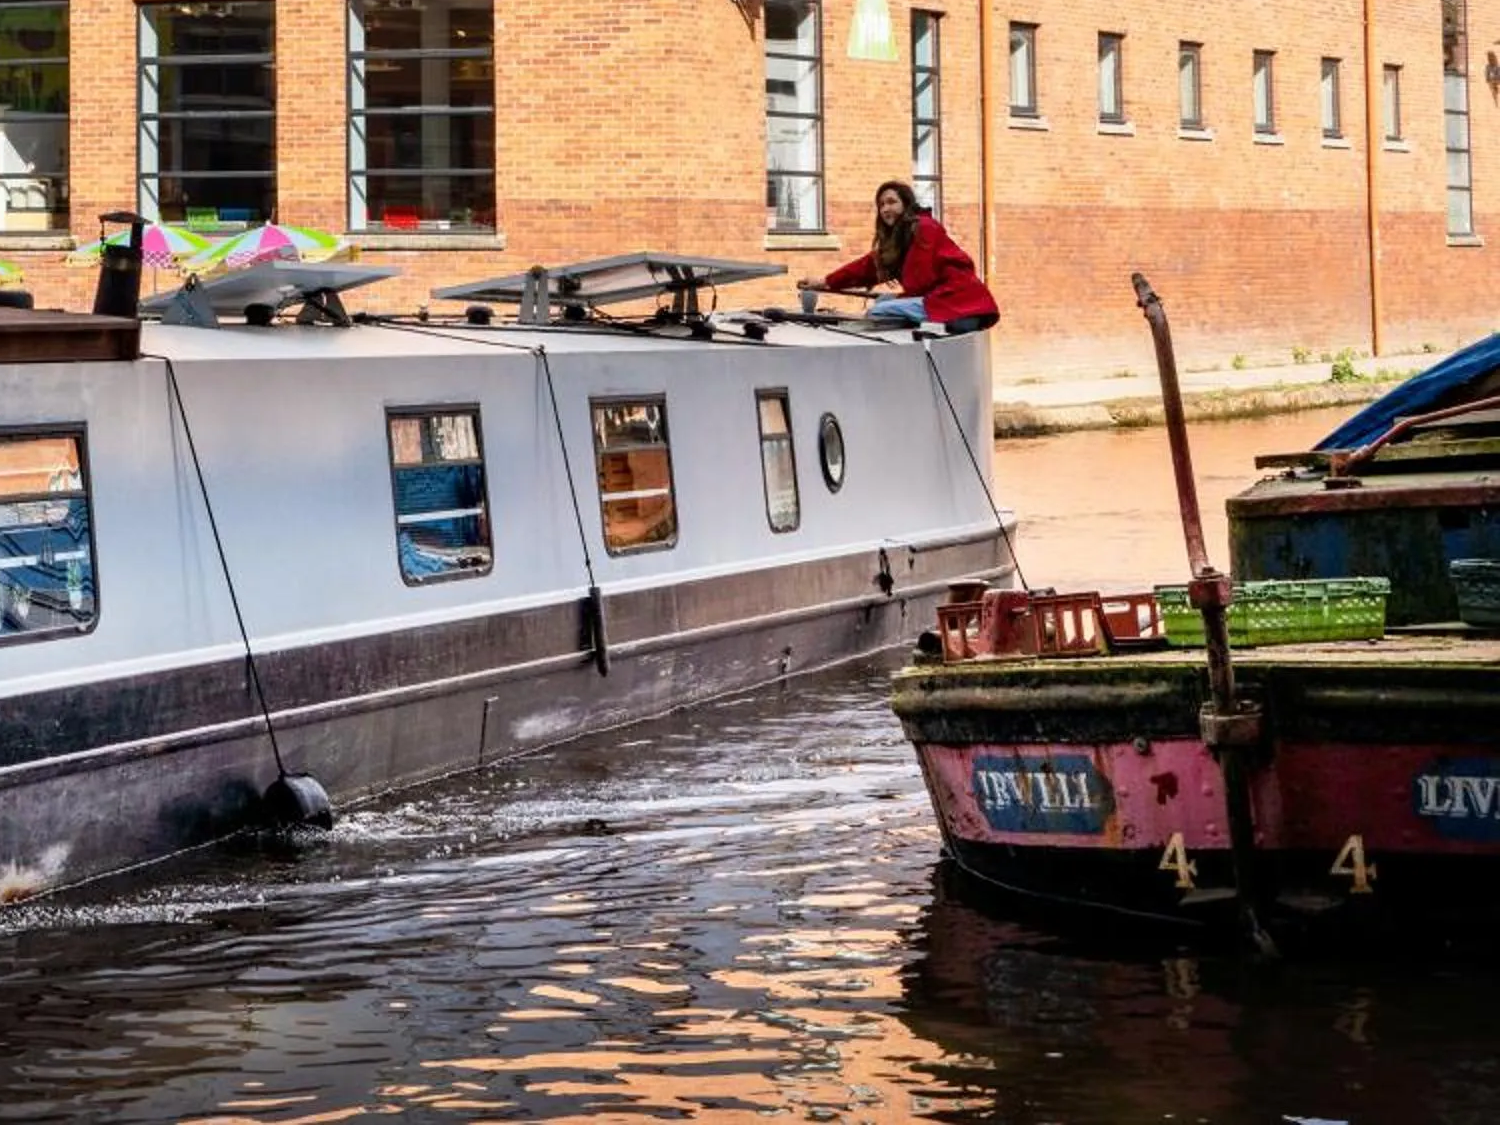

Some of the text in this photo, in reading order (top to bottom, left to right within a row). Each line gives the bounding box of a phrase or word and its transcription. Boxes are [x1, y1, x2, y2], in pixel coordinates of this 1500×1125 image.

[1417, 774, 1500, 819] LIV
[1158, 832, 1198, 888] 4
[1330, 834, 1377, 893] 4
